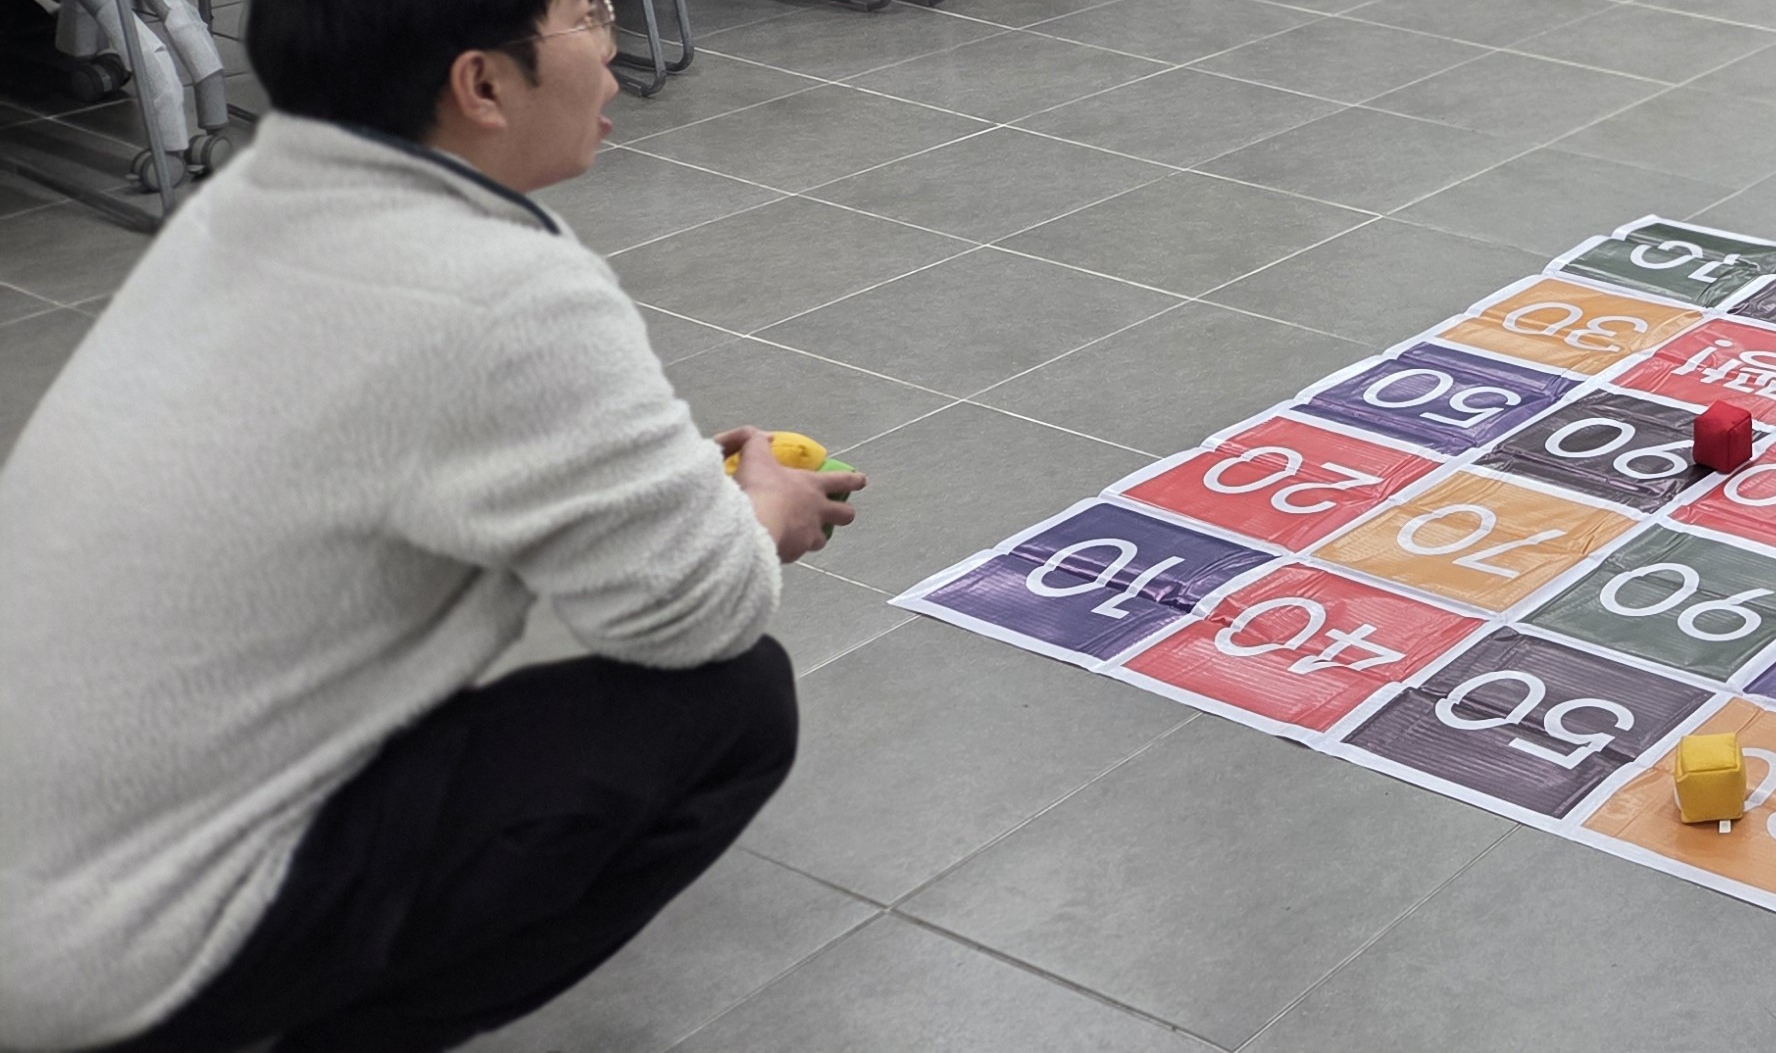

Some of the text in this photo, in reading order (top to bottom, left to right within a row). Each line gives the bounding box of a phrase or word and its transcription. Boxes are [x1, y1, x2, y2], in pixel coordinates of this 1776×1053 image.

[1630, 240, 1742, 283] 10
[1502, 301, 1648, 353] 30
[1363, 368, 1520, 429] 50
[1202, 446, 1383, 514] 20
[1545, 418, 1694, 479] 90
[1397, 503, 1566, 578] 70
[1026, 538, 1184, 619] 10
[1600, 562, 1775, 641] 90
[1215, 597, 1406, 674] 40
[1435, 671, 1633, 770] 50
